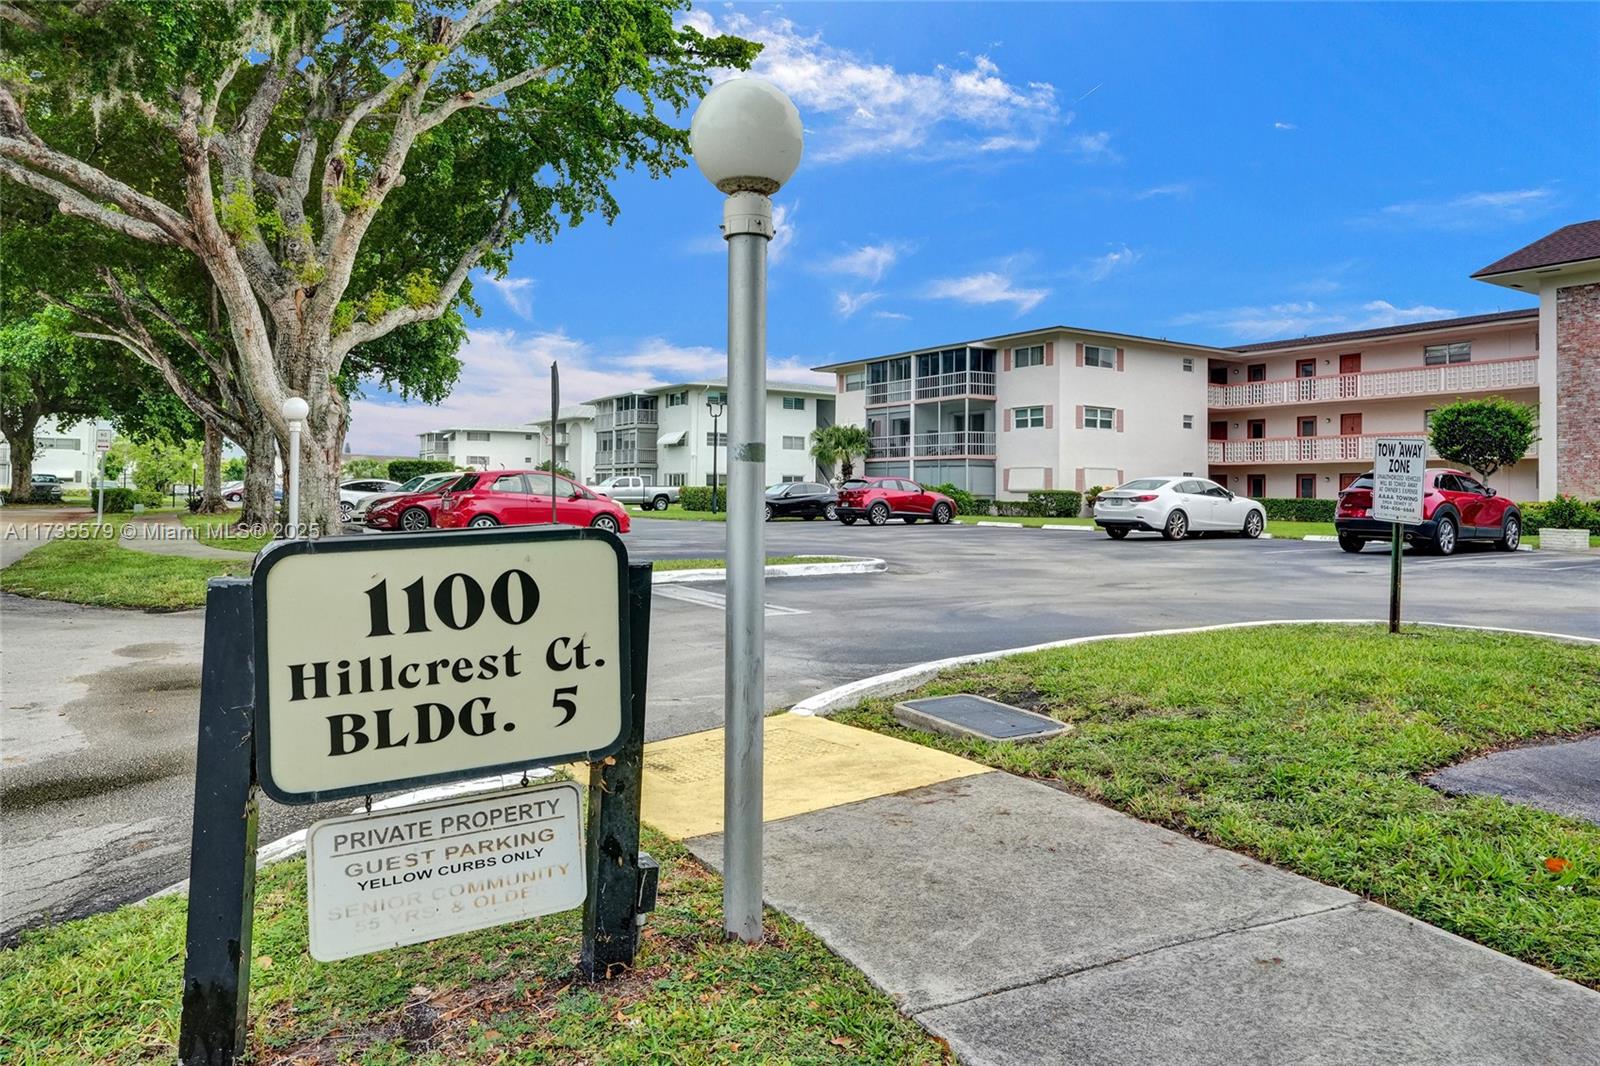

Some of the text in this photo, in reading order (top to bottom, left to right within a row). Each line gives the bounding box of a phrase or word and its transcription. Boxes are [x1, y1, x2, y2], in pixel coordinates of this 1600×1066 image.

[1378, 443, 1422, 458] TOW AWAY
[1389, 459, 1410, 473] ZONE
[363, 568, 540, 638] 1100
[287, 635, 606, 702] Hillcrest Ct.
[325, 684, 579, 757] BLDG. 5
[333, 798, 560, 852] PRIVATE PROPERTY
[344, 828, 555, 878] GUEST PARKING
[357, 847, 545, 891] YELLOW CURBS ONLY
[327, 862, 571, 922] SENIOR COMMUNITY
[450, 899, 466, 915] &
[473, 884, 547, 910] OLDE
